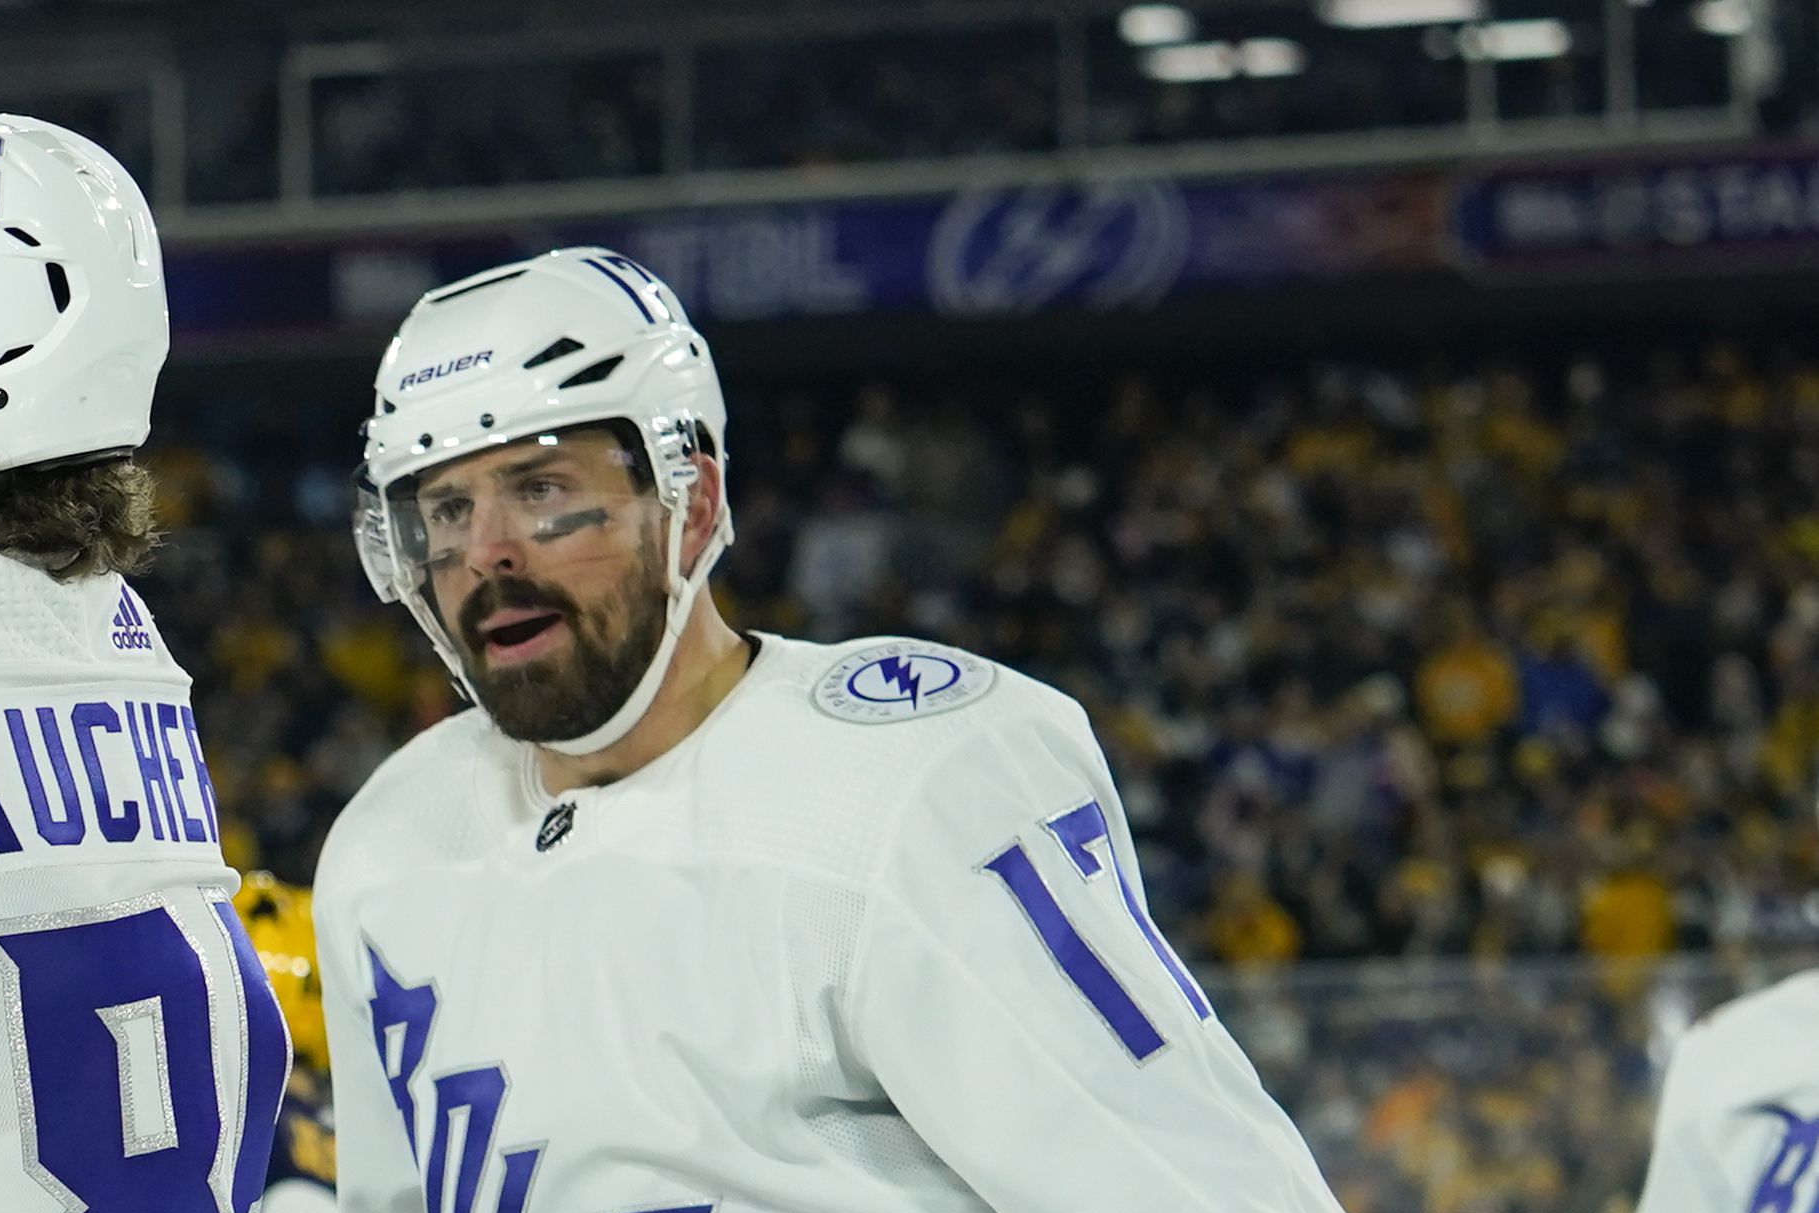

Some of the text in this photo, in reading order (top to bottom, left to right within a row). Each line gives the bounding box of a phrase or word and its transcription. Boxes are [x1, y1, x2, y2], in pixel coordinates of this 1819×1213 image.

[399, 349, 494, 391] BAUER
[112, 627, 153, 650] adidas
[971, 795, 1215, 1069] 17
